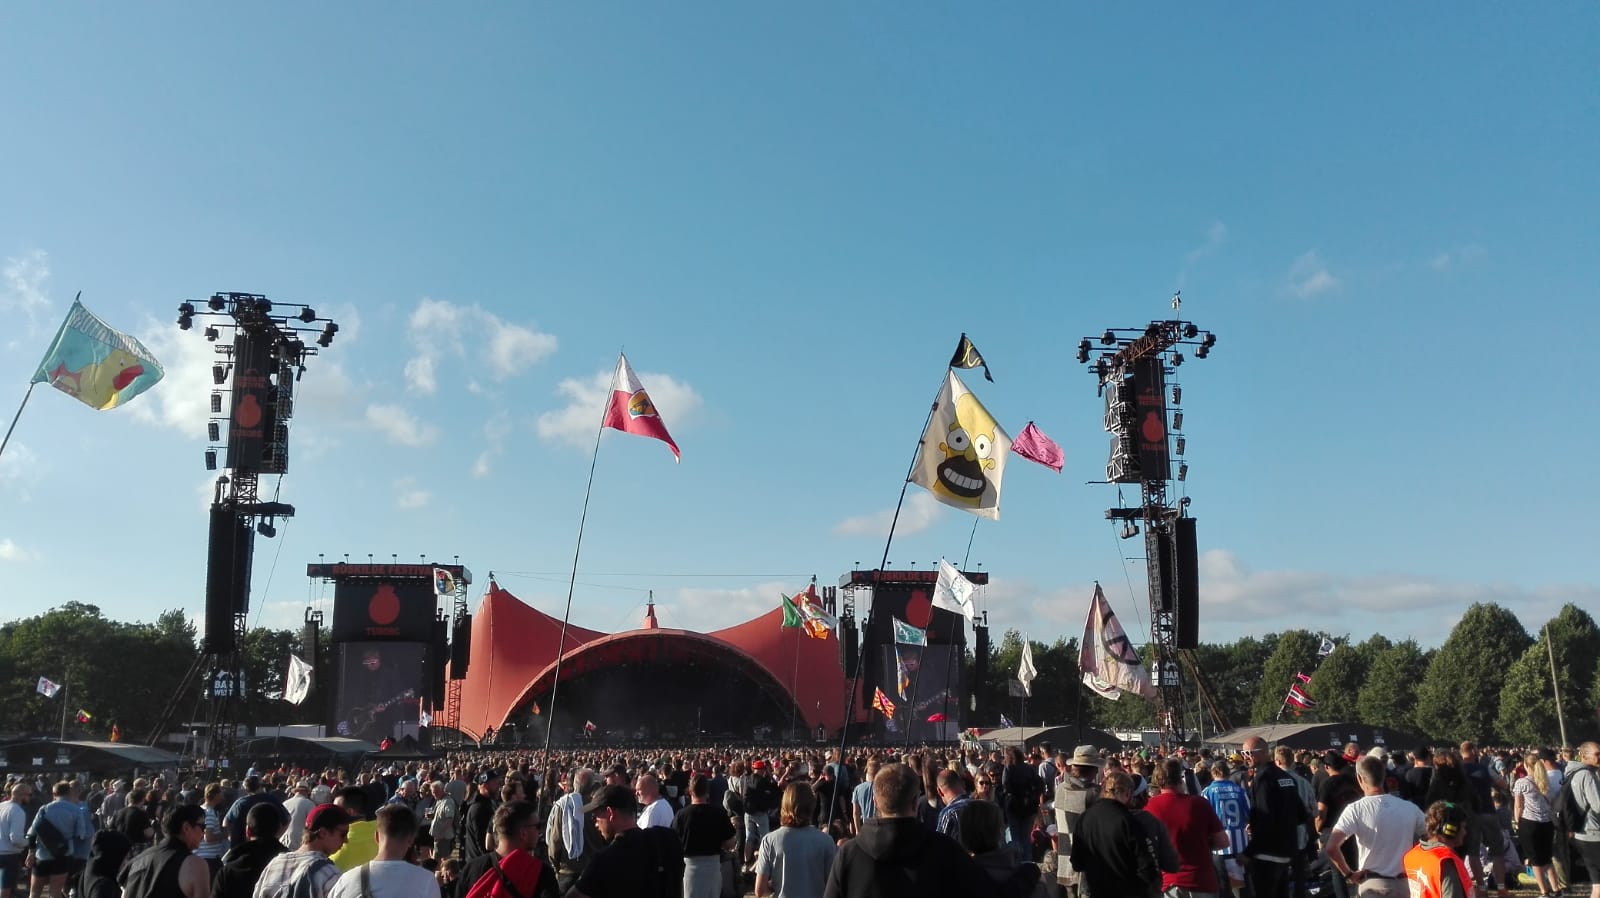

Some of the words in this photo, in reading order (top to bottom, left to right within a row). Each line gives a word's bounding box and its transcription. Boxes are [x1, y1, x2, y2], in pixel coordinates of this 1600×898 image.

[332, 565, 386, 575] ROSKILDE
[388, 566, 434, 576] FESTIVA
[1219, 799, 1240, 828] 19
